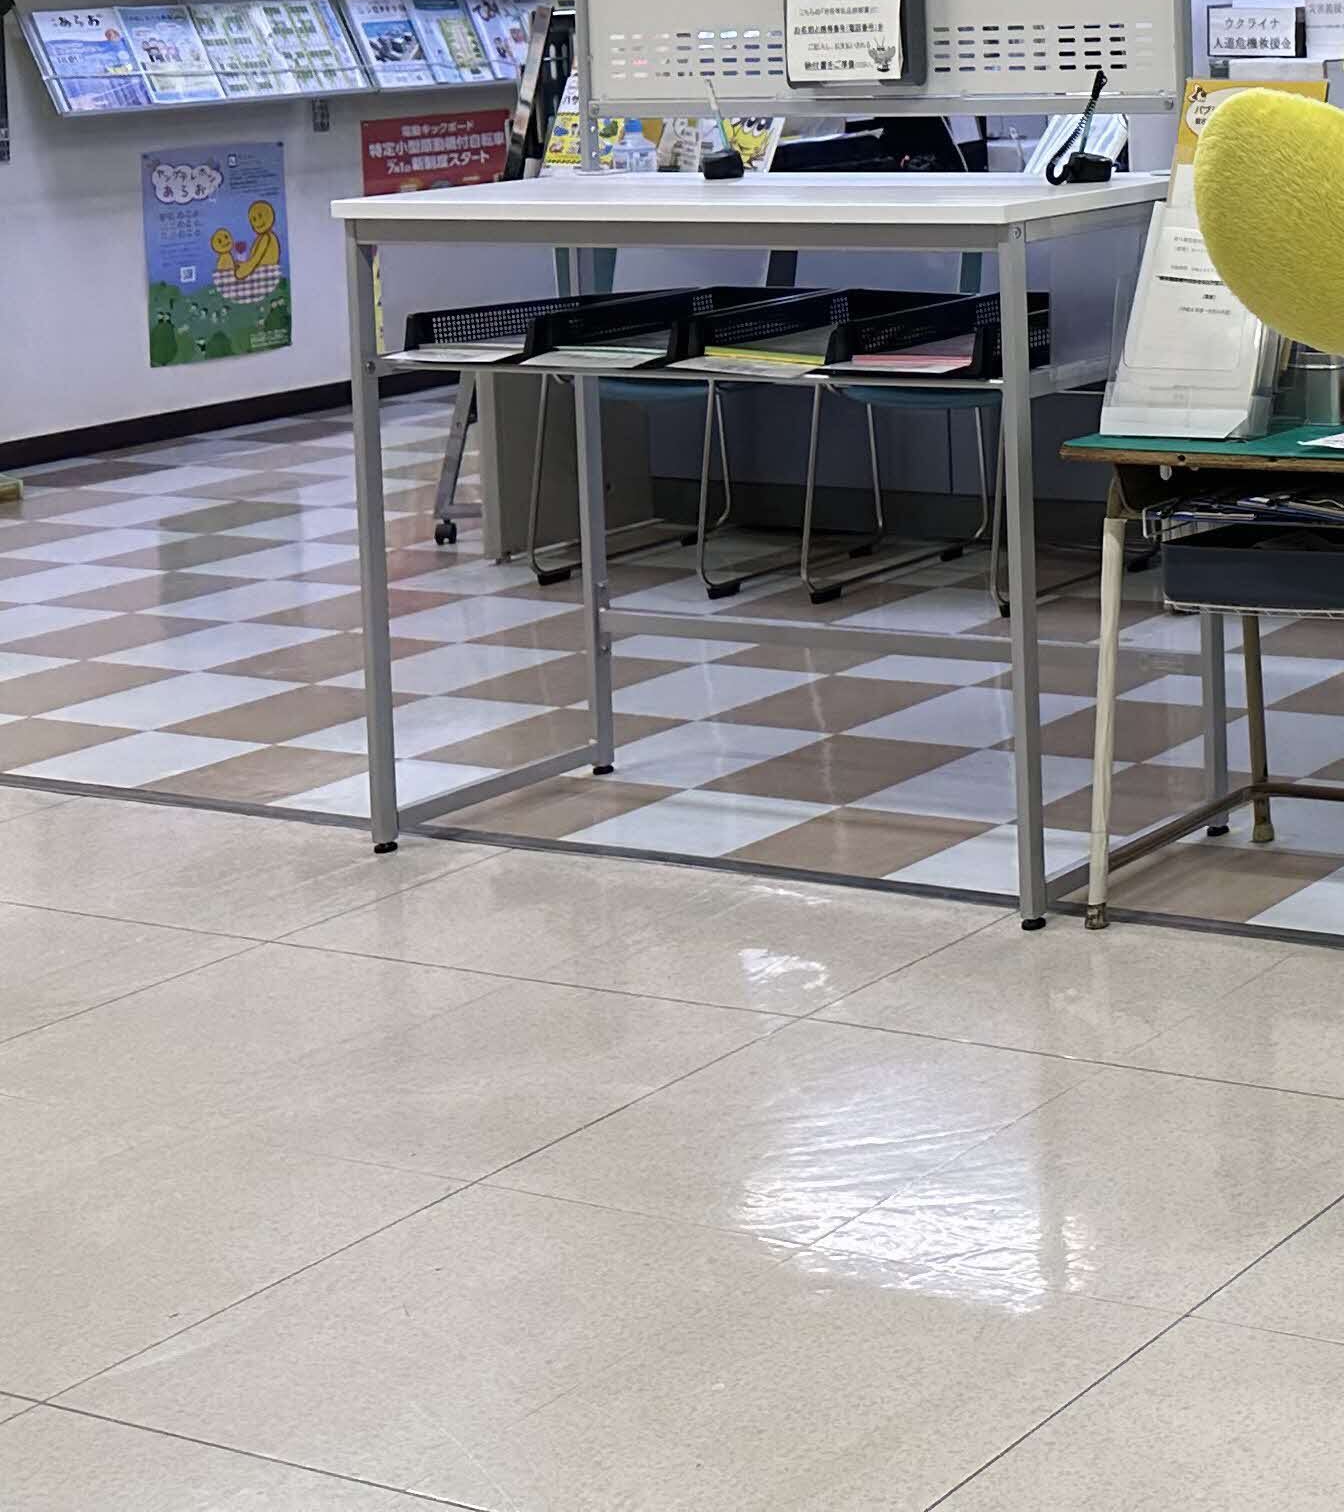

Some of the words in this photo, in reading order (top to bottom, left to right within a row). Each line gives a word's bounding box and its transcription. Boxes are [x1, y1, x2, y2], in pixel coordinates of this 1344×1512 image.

[1224, 17, 1281, 31] ウクライナ
[1212, 37, 1292, 51] 人道危機救援金
